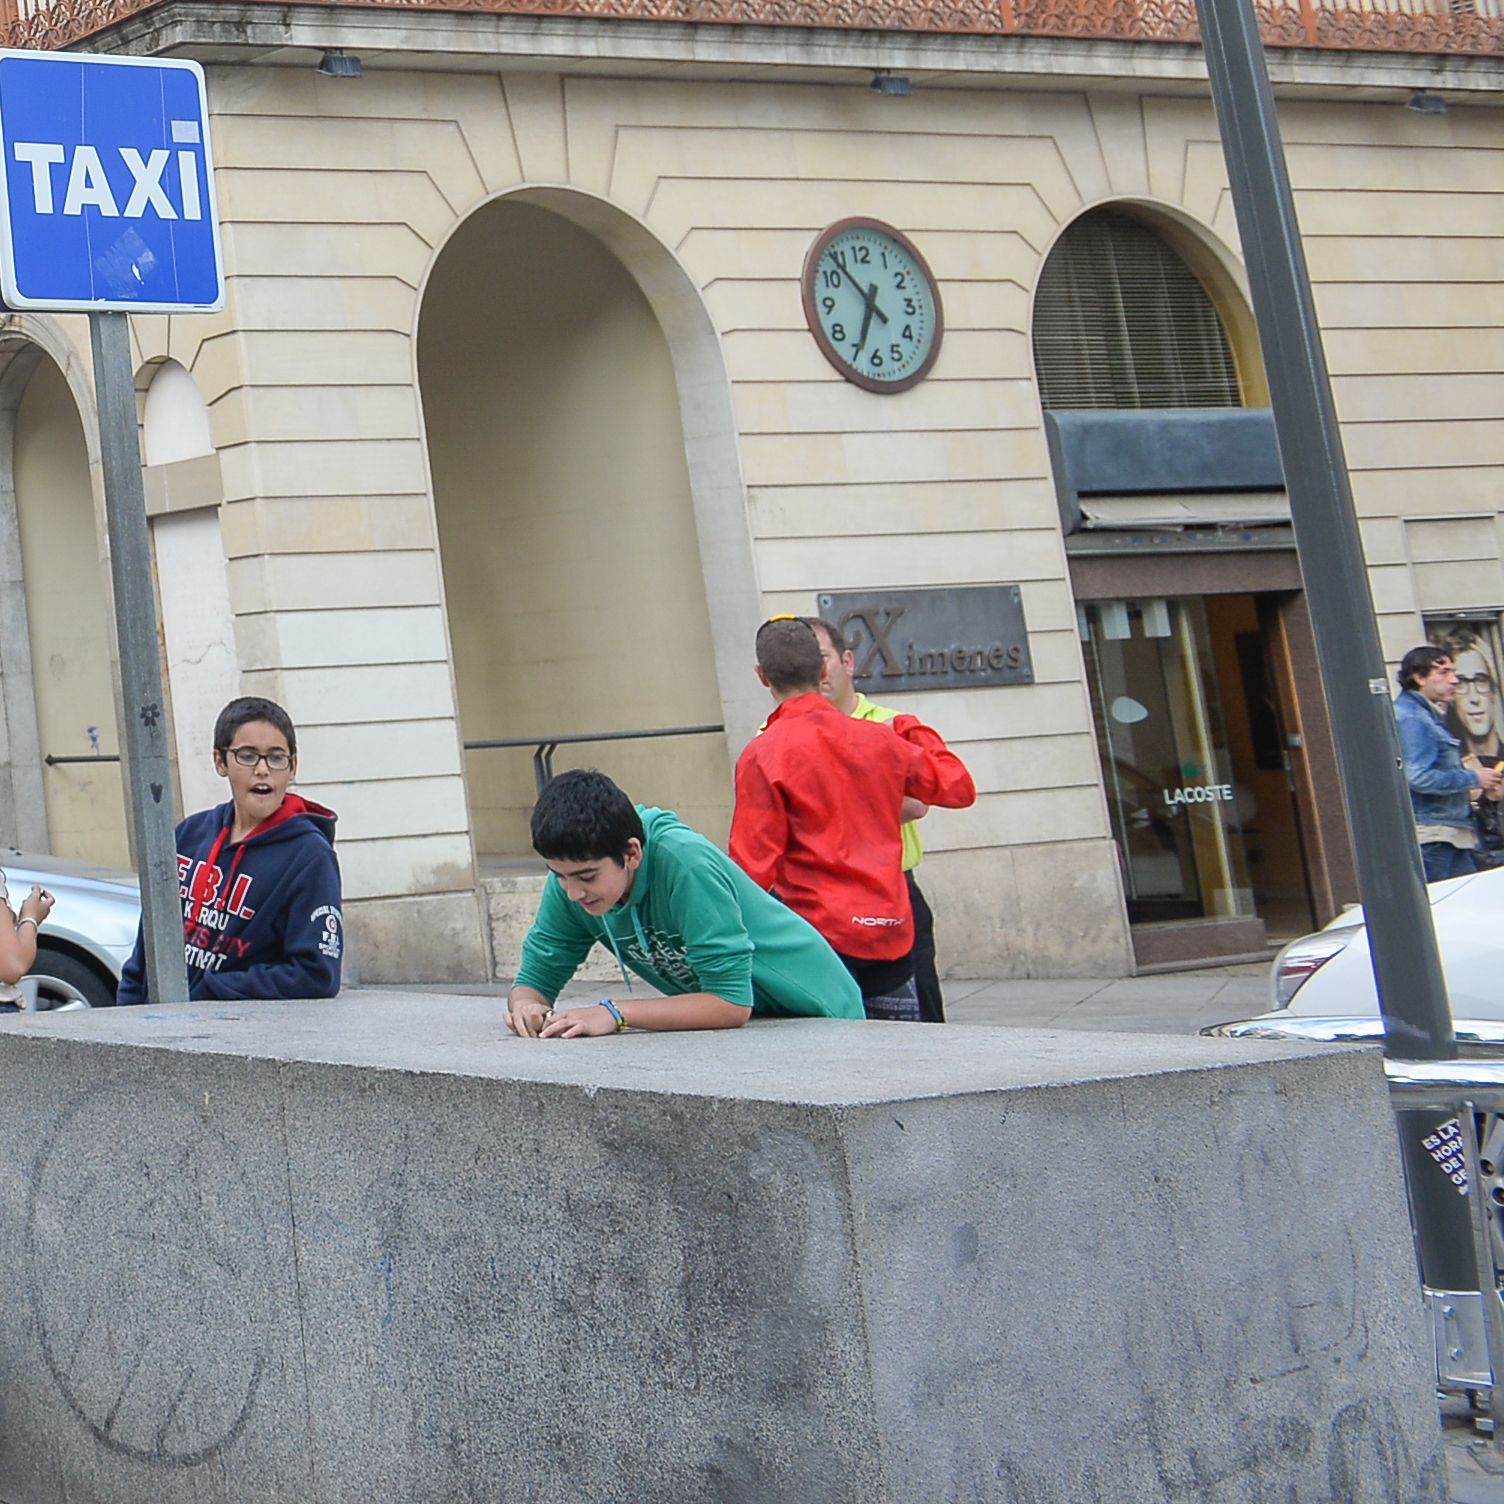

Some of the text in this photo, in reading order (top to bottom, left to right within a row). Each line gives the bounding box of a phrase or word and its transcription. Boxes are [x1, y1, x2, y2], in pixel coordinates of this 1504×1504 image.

[851, 246, 871, 264] 12
[881, 252, 888, 270] 1
[823, 270, 841, 288] 10
[894, 272, 906, 290] 2
[822, 297, 835, 316] 9
[903, 298, 916, 316] 3
[832, 323, 846, 342] 8
[902, 324, 913, 342] 4
[870, 348, 883, 367] 6
[890, 344, 903, 362] 5
[837, 607, 1024, 679] Ximenes
[1163, 784, 1234, 805] LACOSTE
[1421, 1125, 1459, 1150] ES LA
